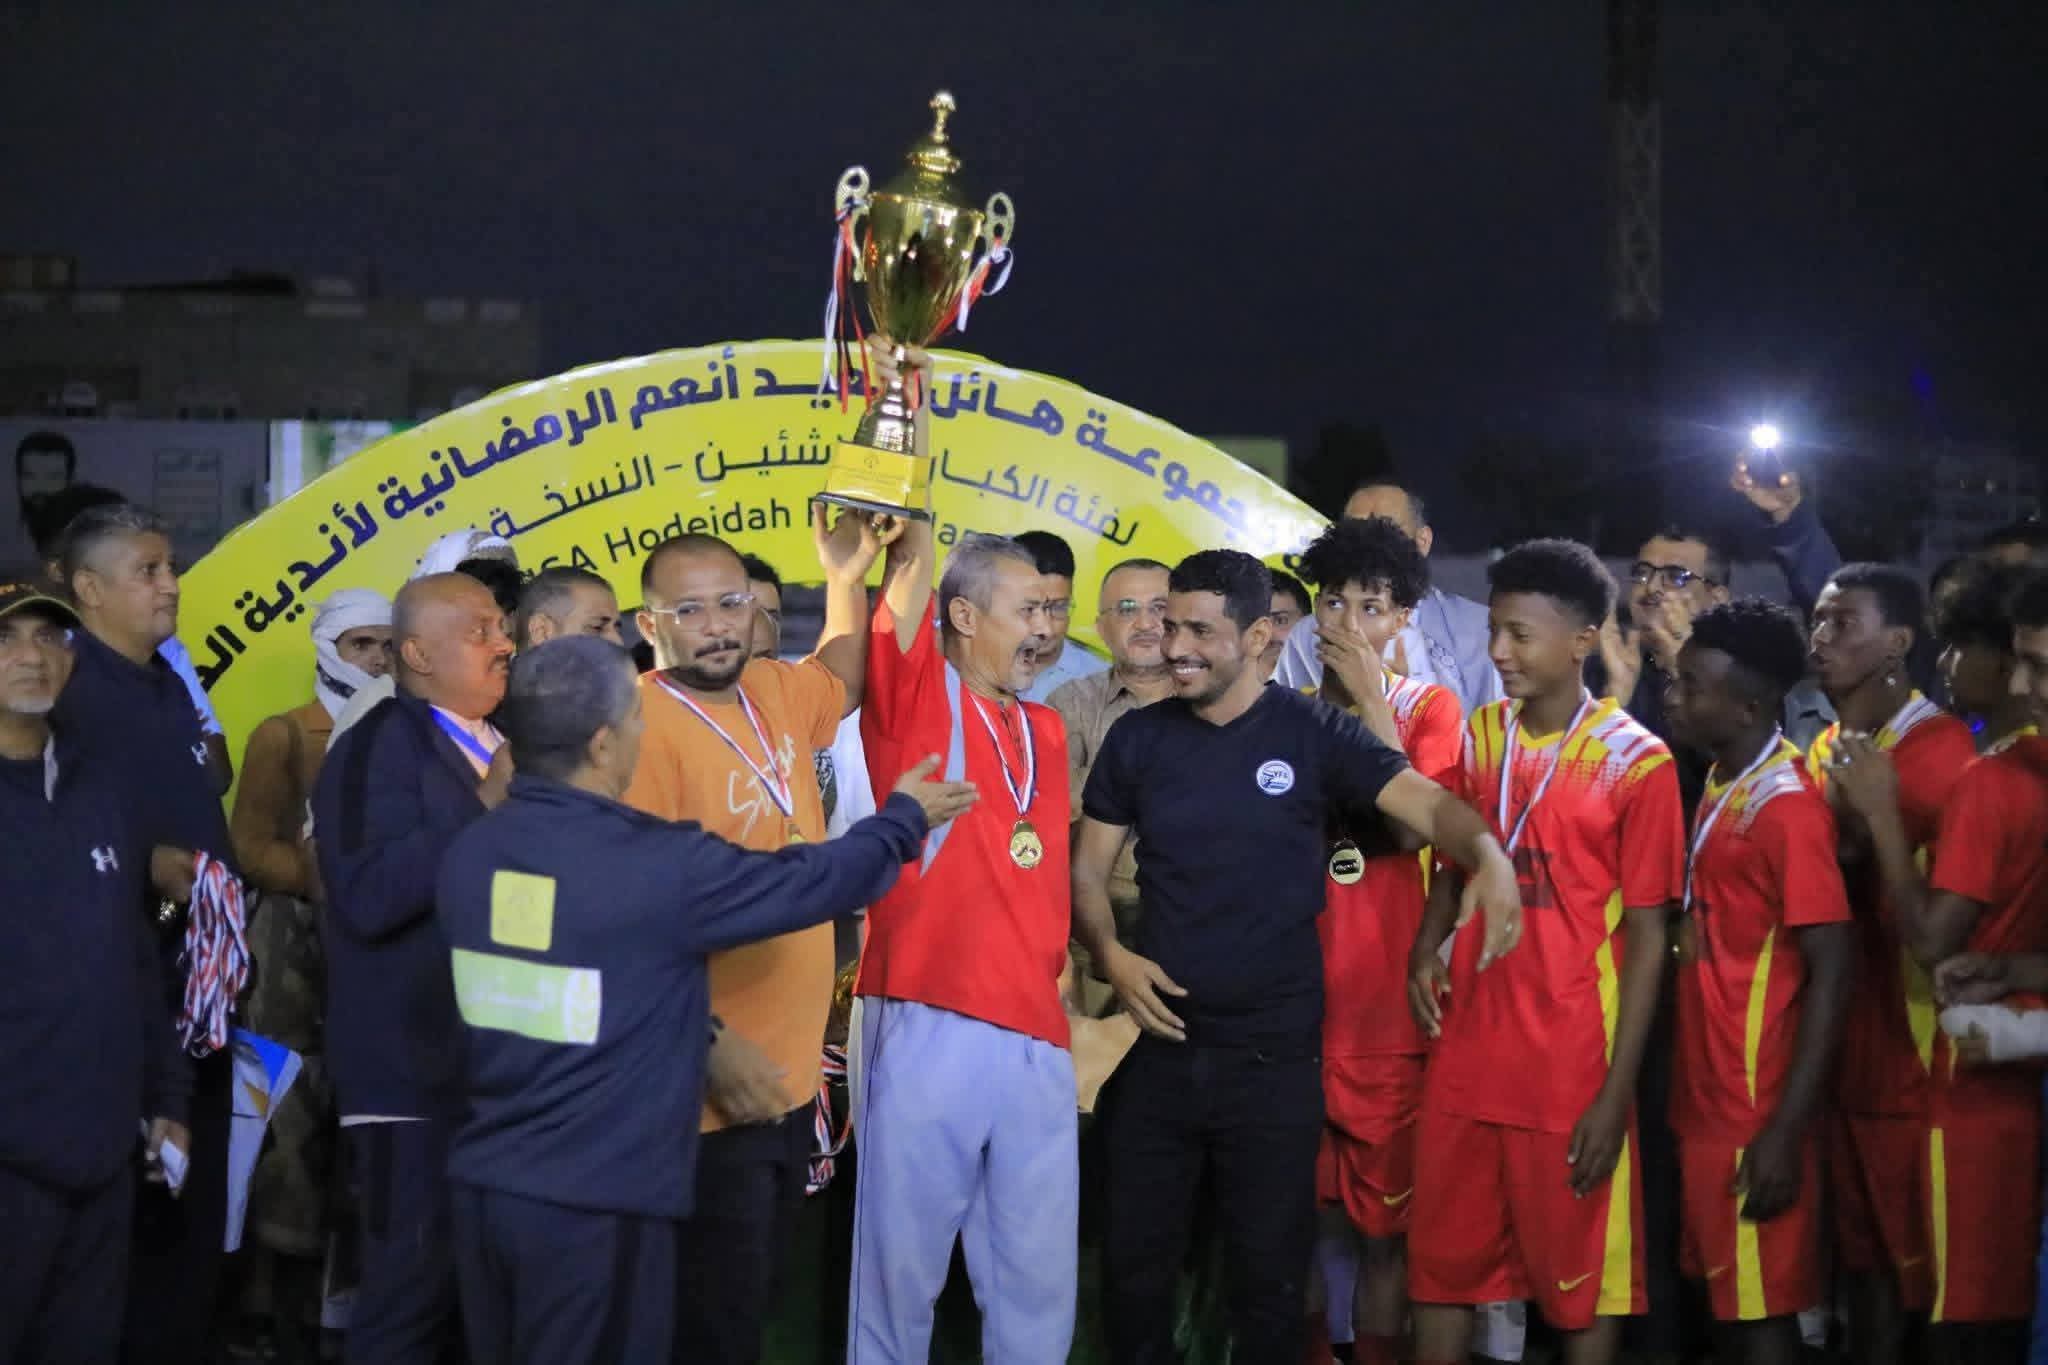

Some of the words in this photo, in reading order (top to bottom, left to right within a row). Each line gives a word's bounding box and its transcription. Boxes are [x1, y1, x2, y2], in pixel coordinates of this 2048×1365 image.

[630, 346, 738, 430] أنعم
[377, 387, 617, 519] الرمضانية
[488, 453, 655, 538] النسخة
[234, 502, 379, 632] لأندية
[604, 498, 792, 562] Hodeidah
